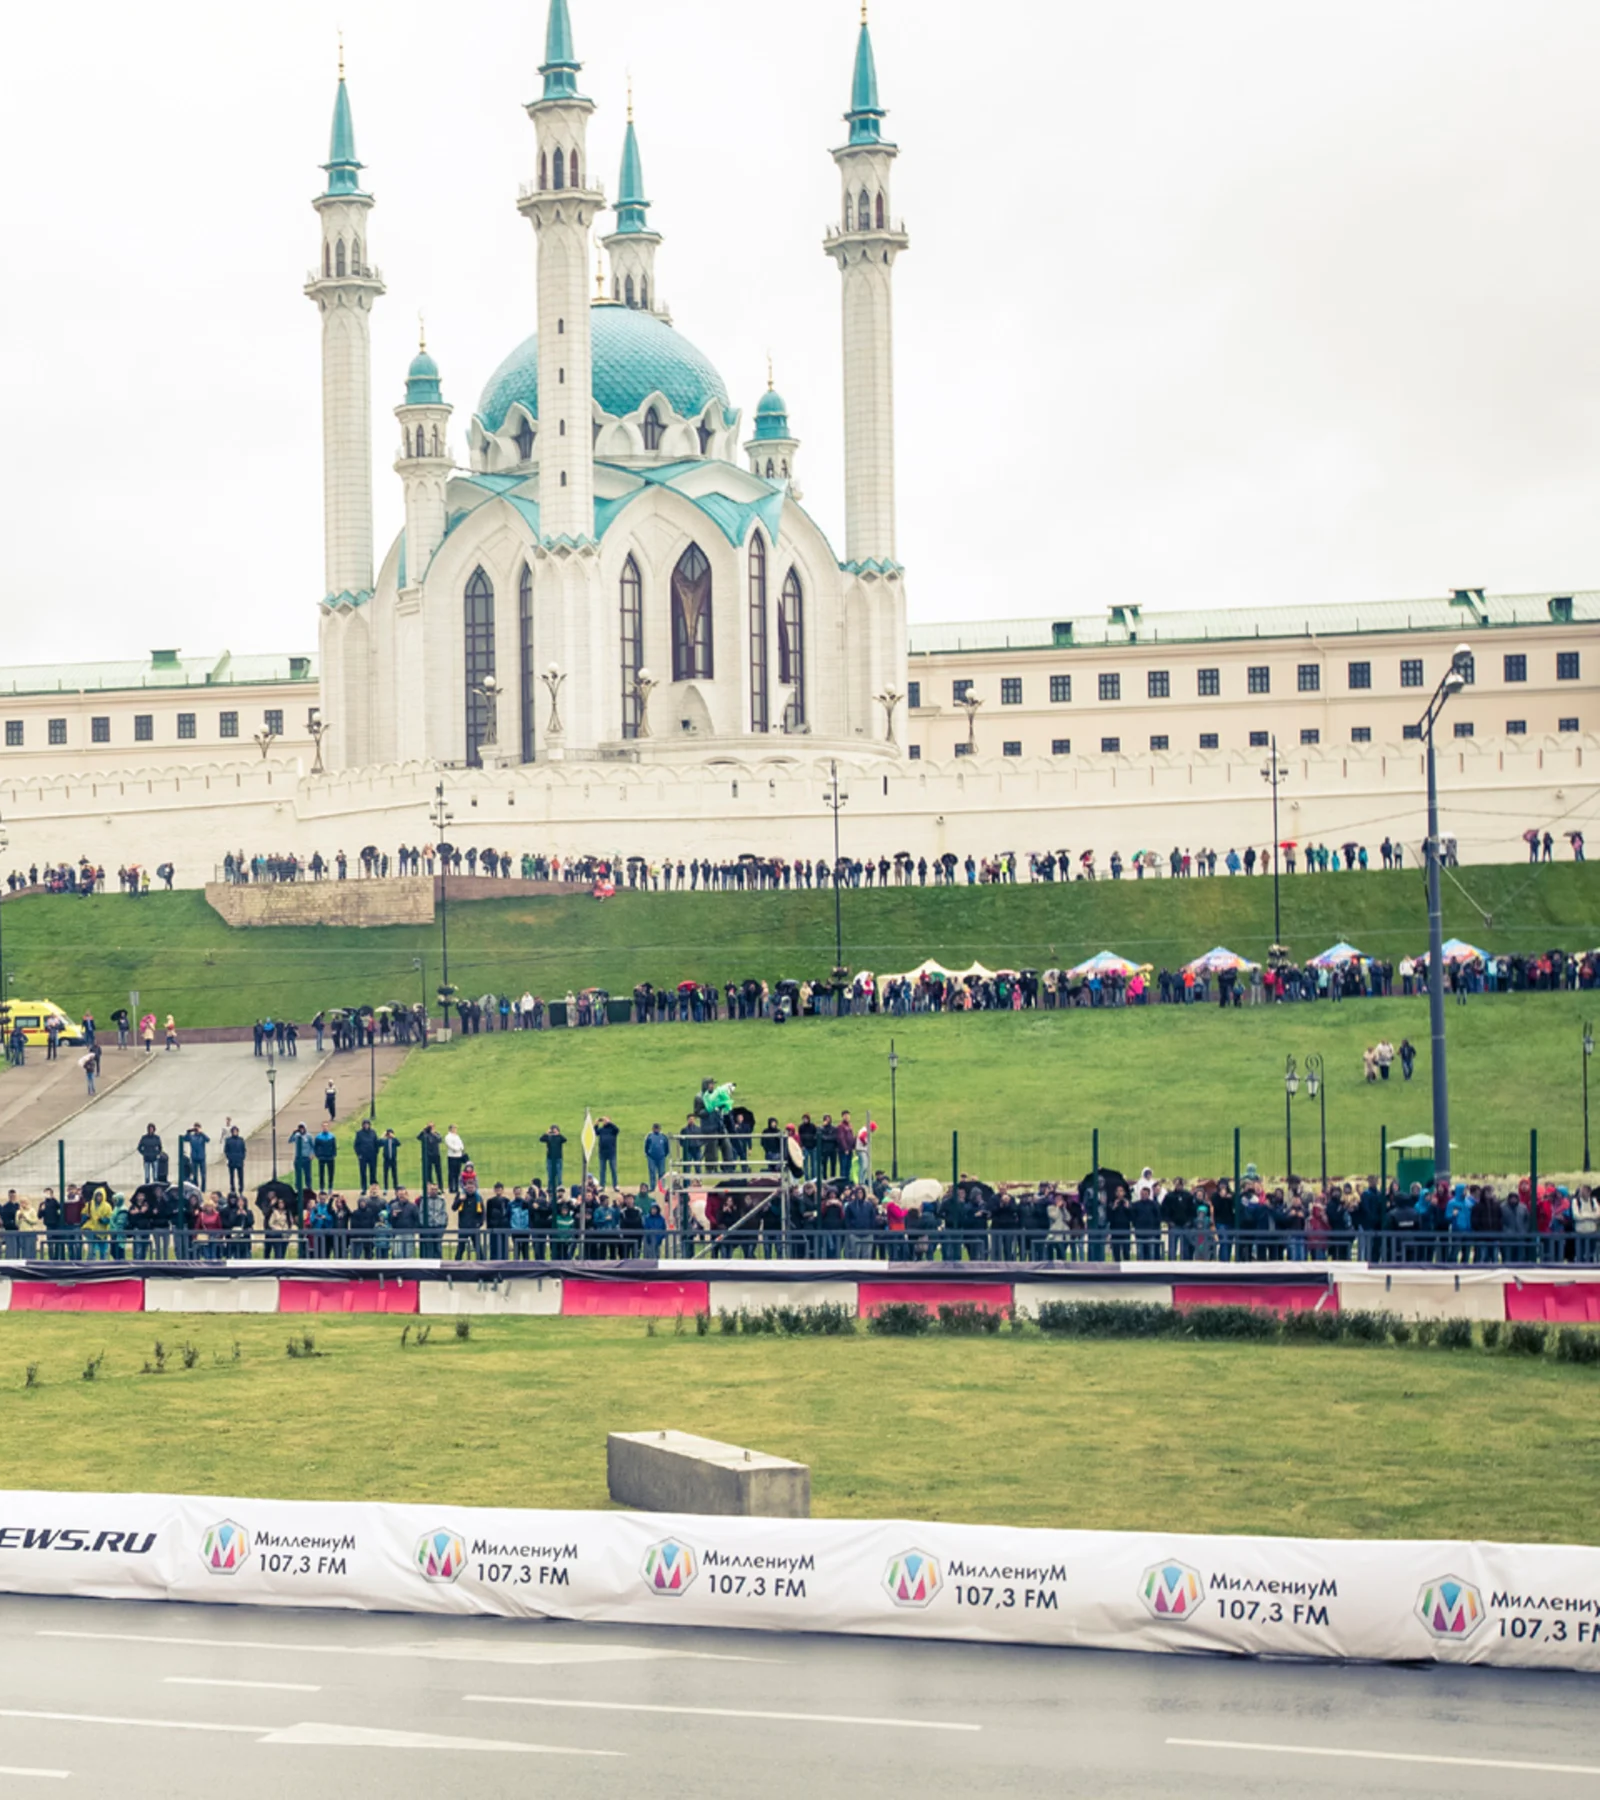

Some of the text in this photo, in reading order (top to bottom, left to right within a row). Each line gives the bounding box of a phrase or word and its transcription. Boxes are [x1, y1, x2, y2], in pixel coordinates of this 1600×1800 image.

[259, 1553, 348, 1576] 107,3 FM
[477, 1563, 570, 1586] 107,3 FM
[707, 1574, 807, 1598] 107,3 FM
[954, 1585, 1059, 1611] 107,3 FM
[1217, 1599, 1330, 1627] 107,3 FM
[1499, 1617, 1568, 1643] 107,3
